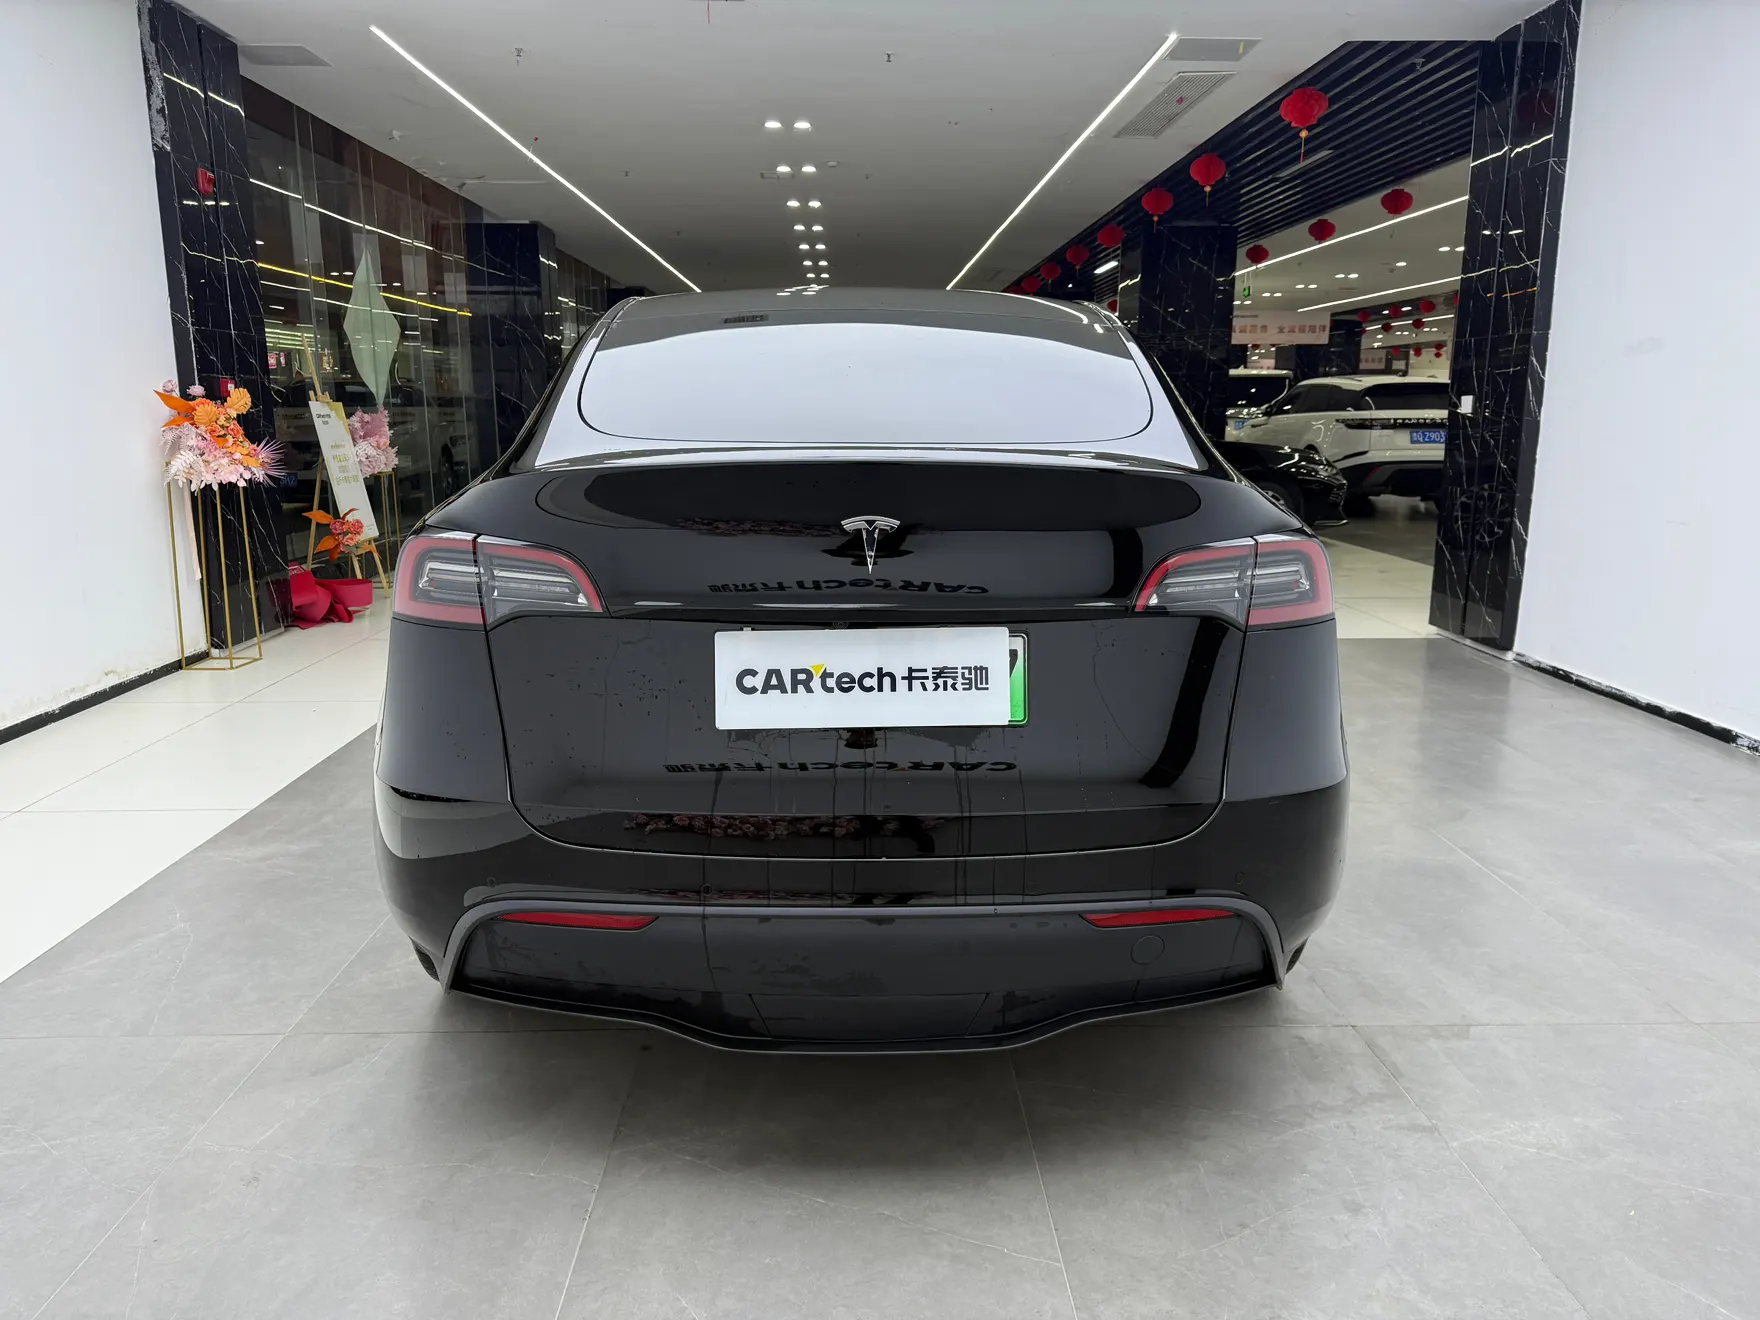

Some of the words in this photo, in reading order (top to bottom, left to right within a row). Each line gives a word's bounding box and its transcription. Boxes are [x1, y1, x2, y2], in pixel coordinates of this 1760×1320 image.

[735, 664, 897, 695] CARtech
[901, 665, 989, 692] 卡泰驰
